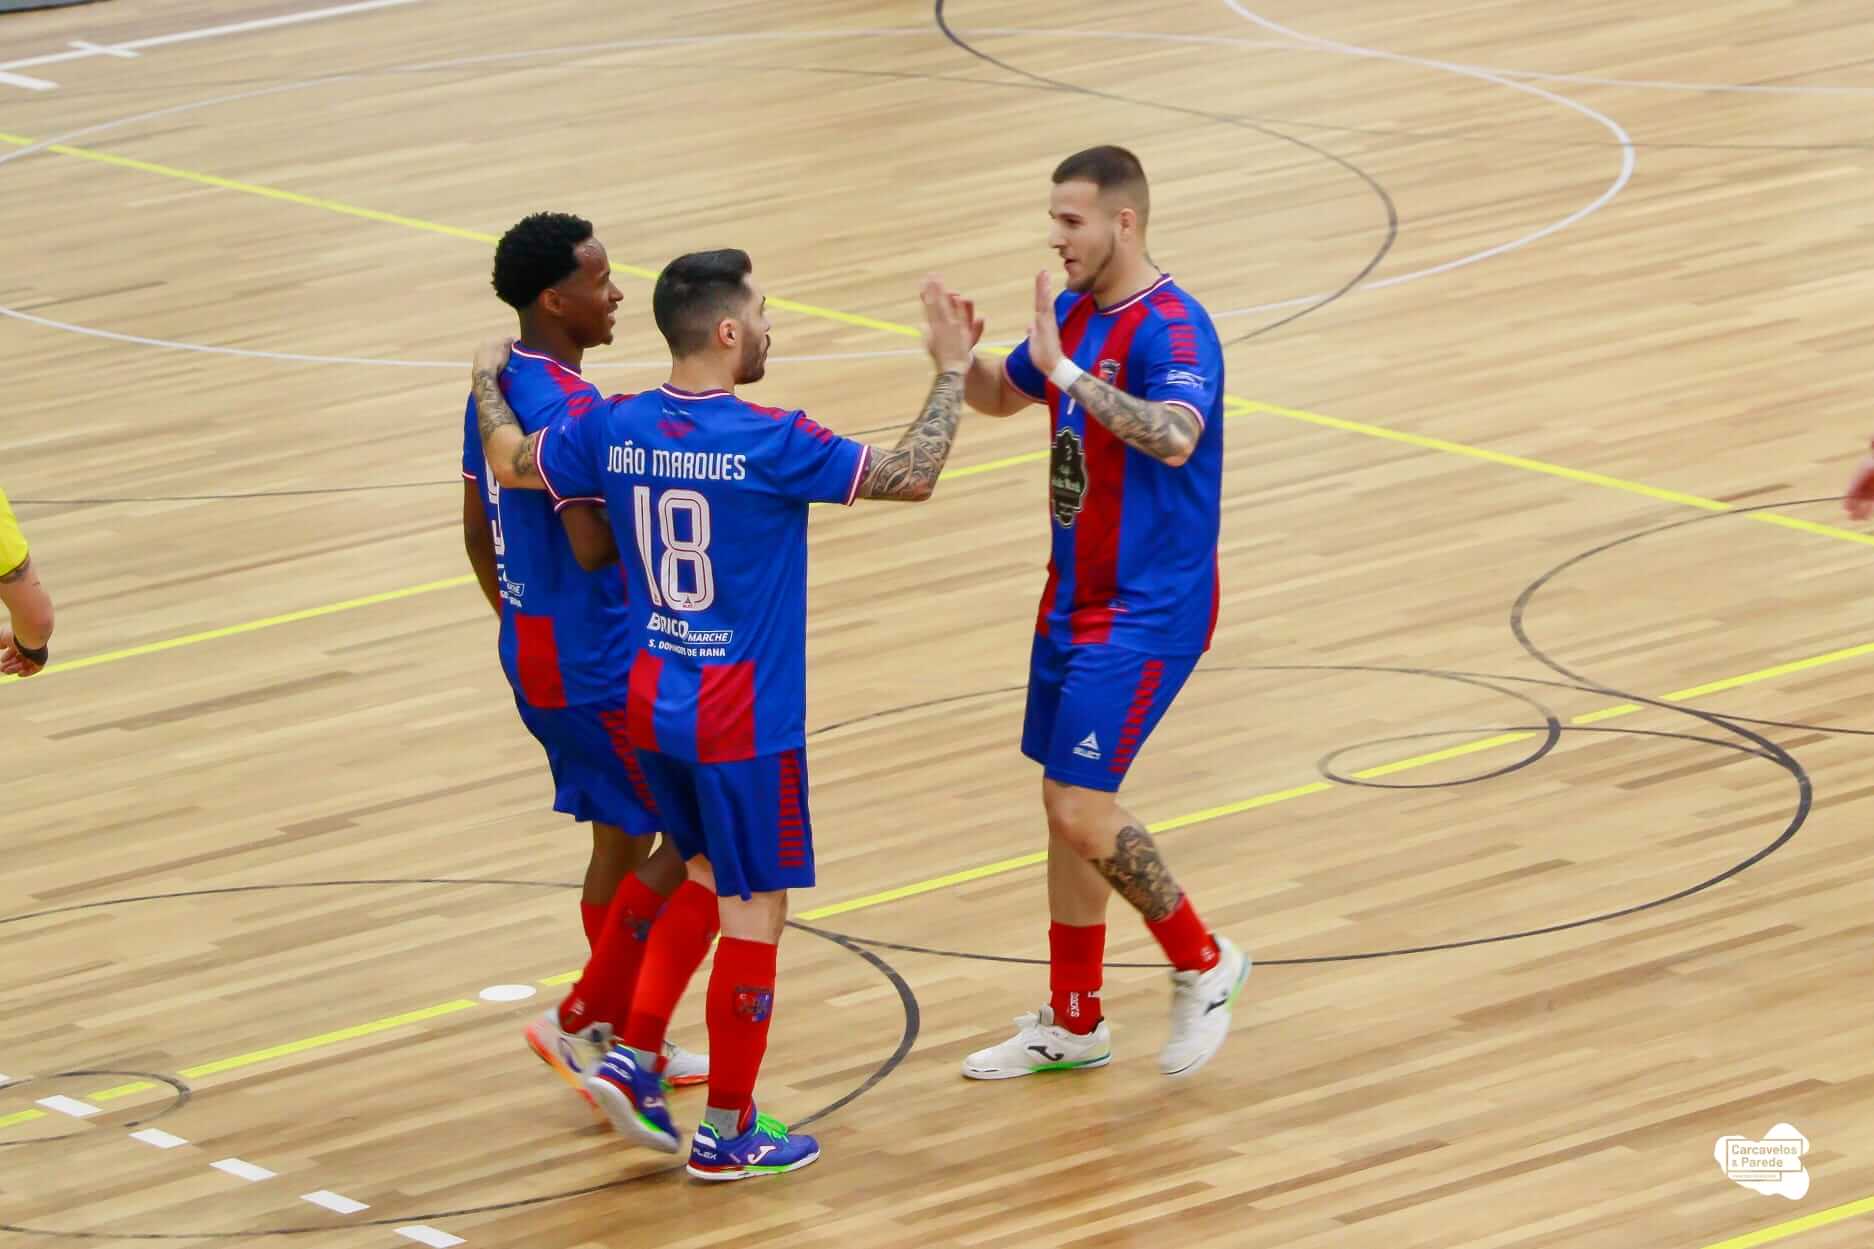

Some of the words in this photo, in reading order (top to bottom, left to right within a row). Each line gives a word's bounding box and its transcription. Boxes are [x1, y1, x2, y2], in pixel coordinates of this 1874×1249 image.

[607, 440, 646, 475] JOÃO
[652, 449, 746, 481] MARQUES
[633, 484, 715, 612] 18
[646, 611, 689, 639] BRICO
[687, 648, 697, 657] DE
[699, 648, 726, 657] RANA
